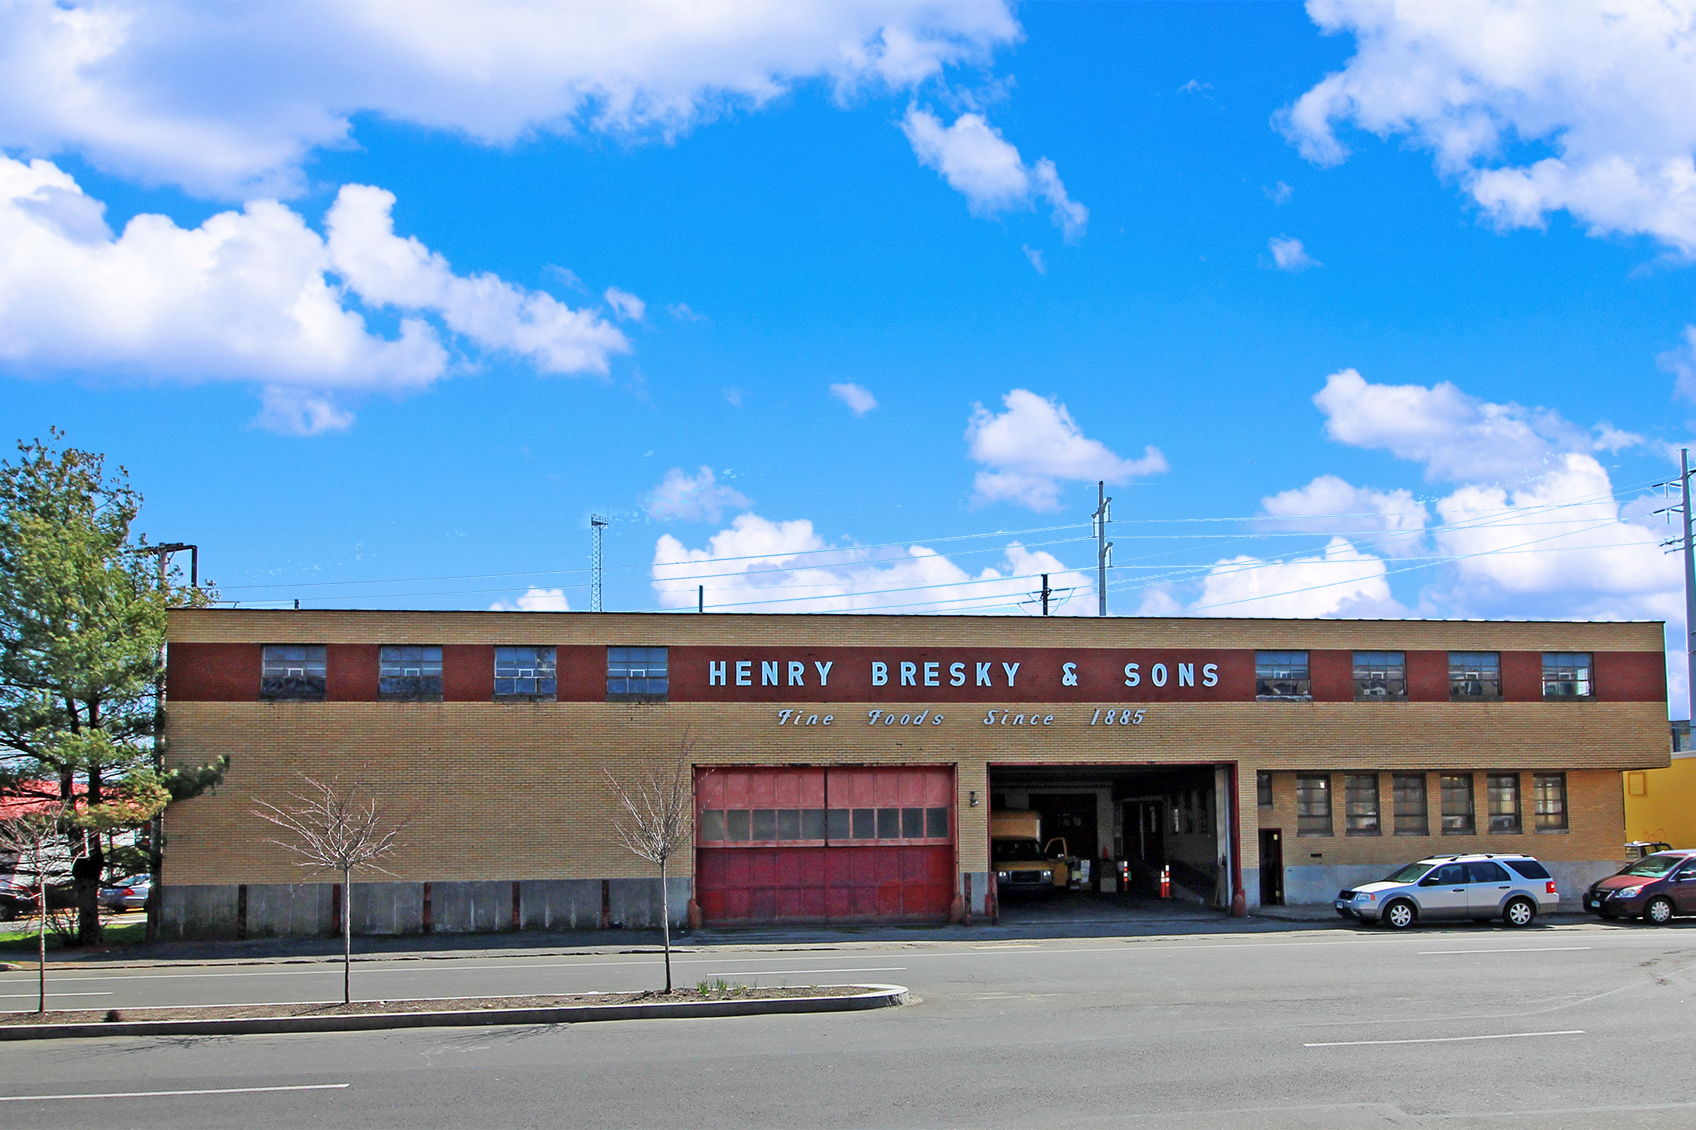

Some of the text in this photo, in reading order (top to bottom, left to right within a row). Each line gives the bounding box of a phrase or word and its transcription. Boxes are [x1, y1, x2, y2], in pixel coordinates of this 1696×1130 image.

[709, 660, 1219, 687] HENRY BRESKY & SONS
[777, 708, 1148, 726] Fine Foods Since 1885
